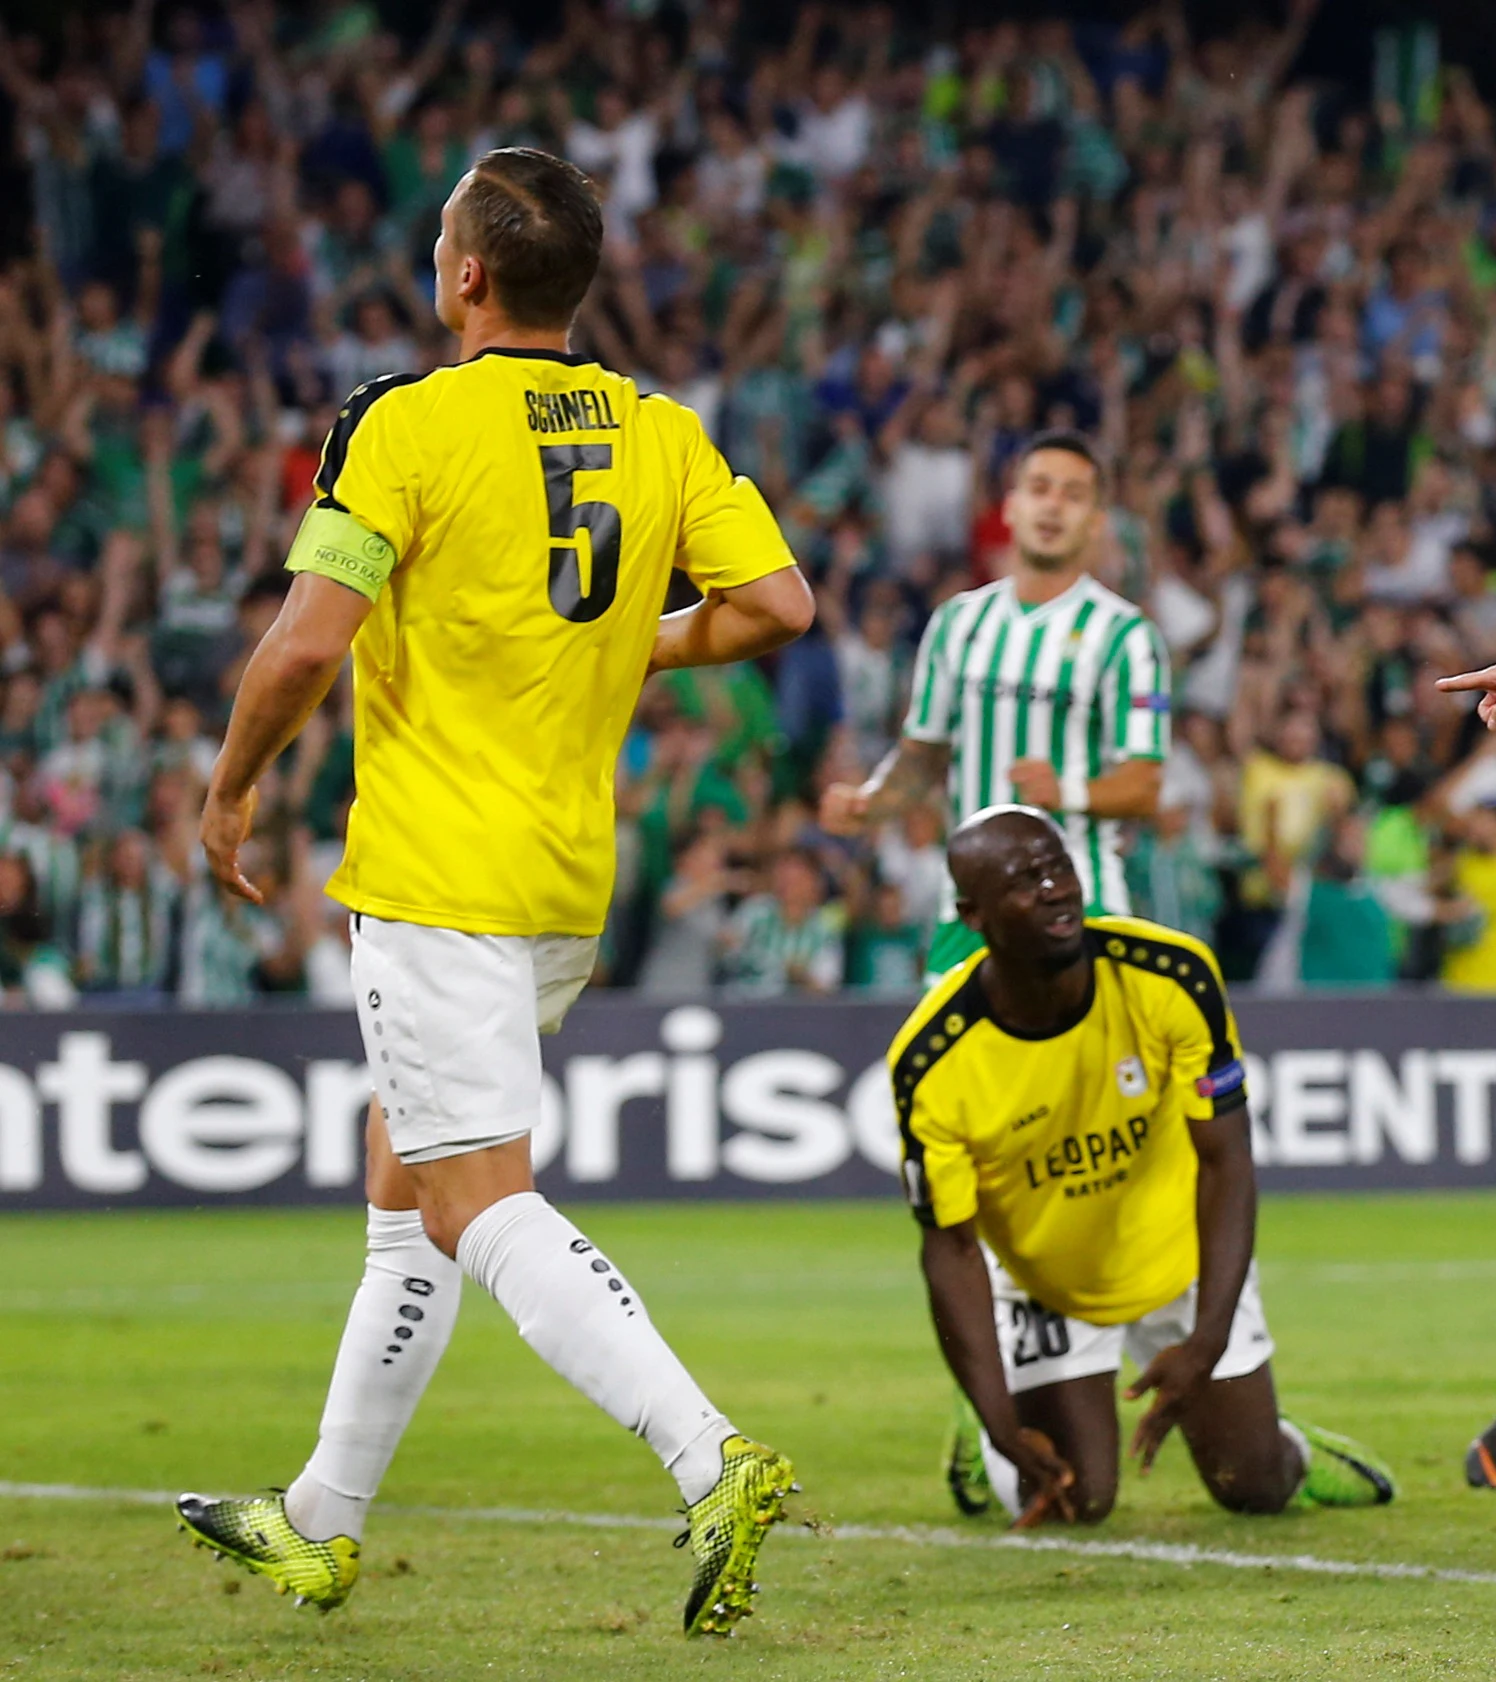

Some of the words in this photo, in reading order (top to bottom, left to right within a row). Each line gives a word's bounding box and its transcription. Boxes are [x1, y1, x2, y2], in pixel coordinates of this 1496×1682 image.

[525, 389, 620, 433] SCHNELL
[314, 548, 337, 563] NO
[340, 558, 358, 572] TO
[538, 443, 622, 623] 5
[0, 1006, 902, 1192] terris
